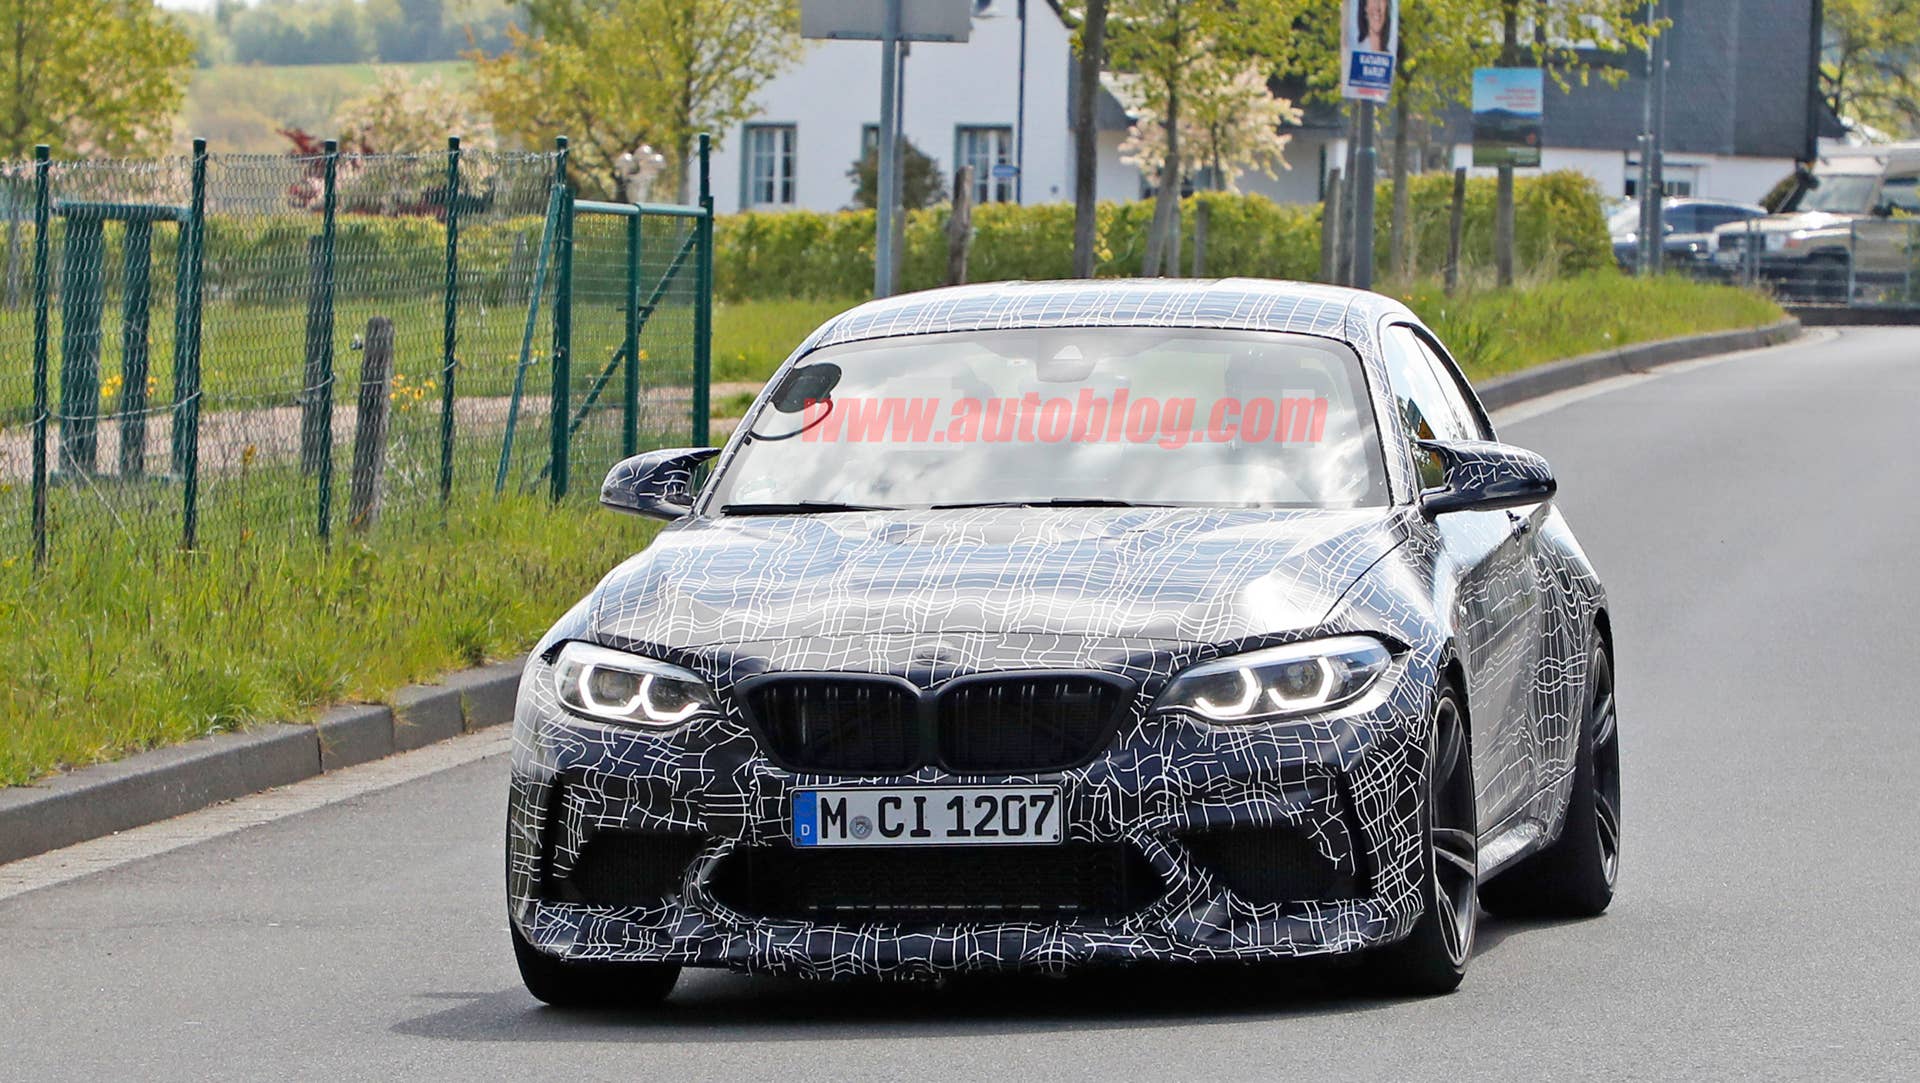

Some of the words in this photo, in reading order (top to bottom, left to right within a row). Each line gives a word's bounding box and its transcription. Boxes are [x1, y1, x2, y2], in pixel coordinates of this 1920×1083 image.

[801, 824, 810, 836] D
[821, 797, 847, 839] M
[878, 796, 931, 838] CI
[946, 794, 1054, 837] 1207
